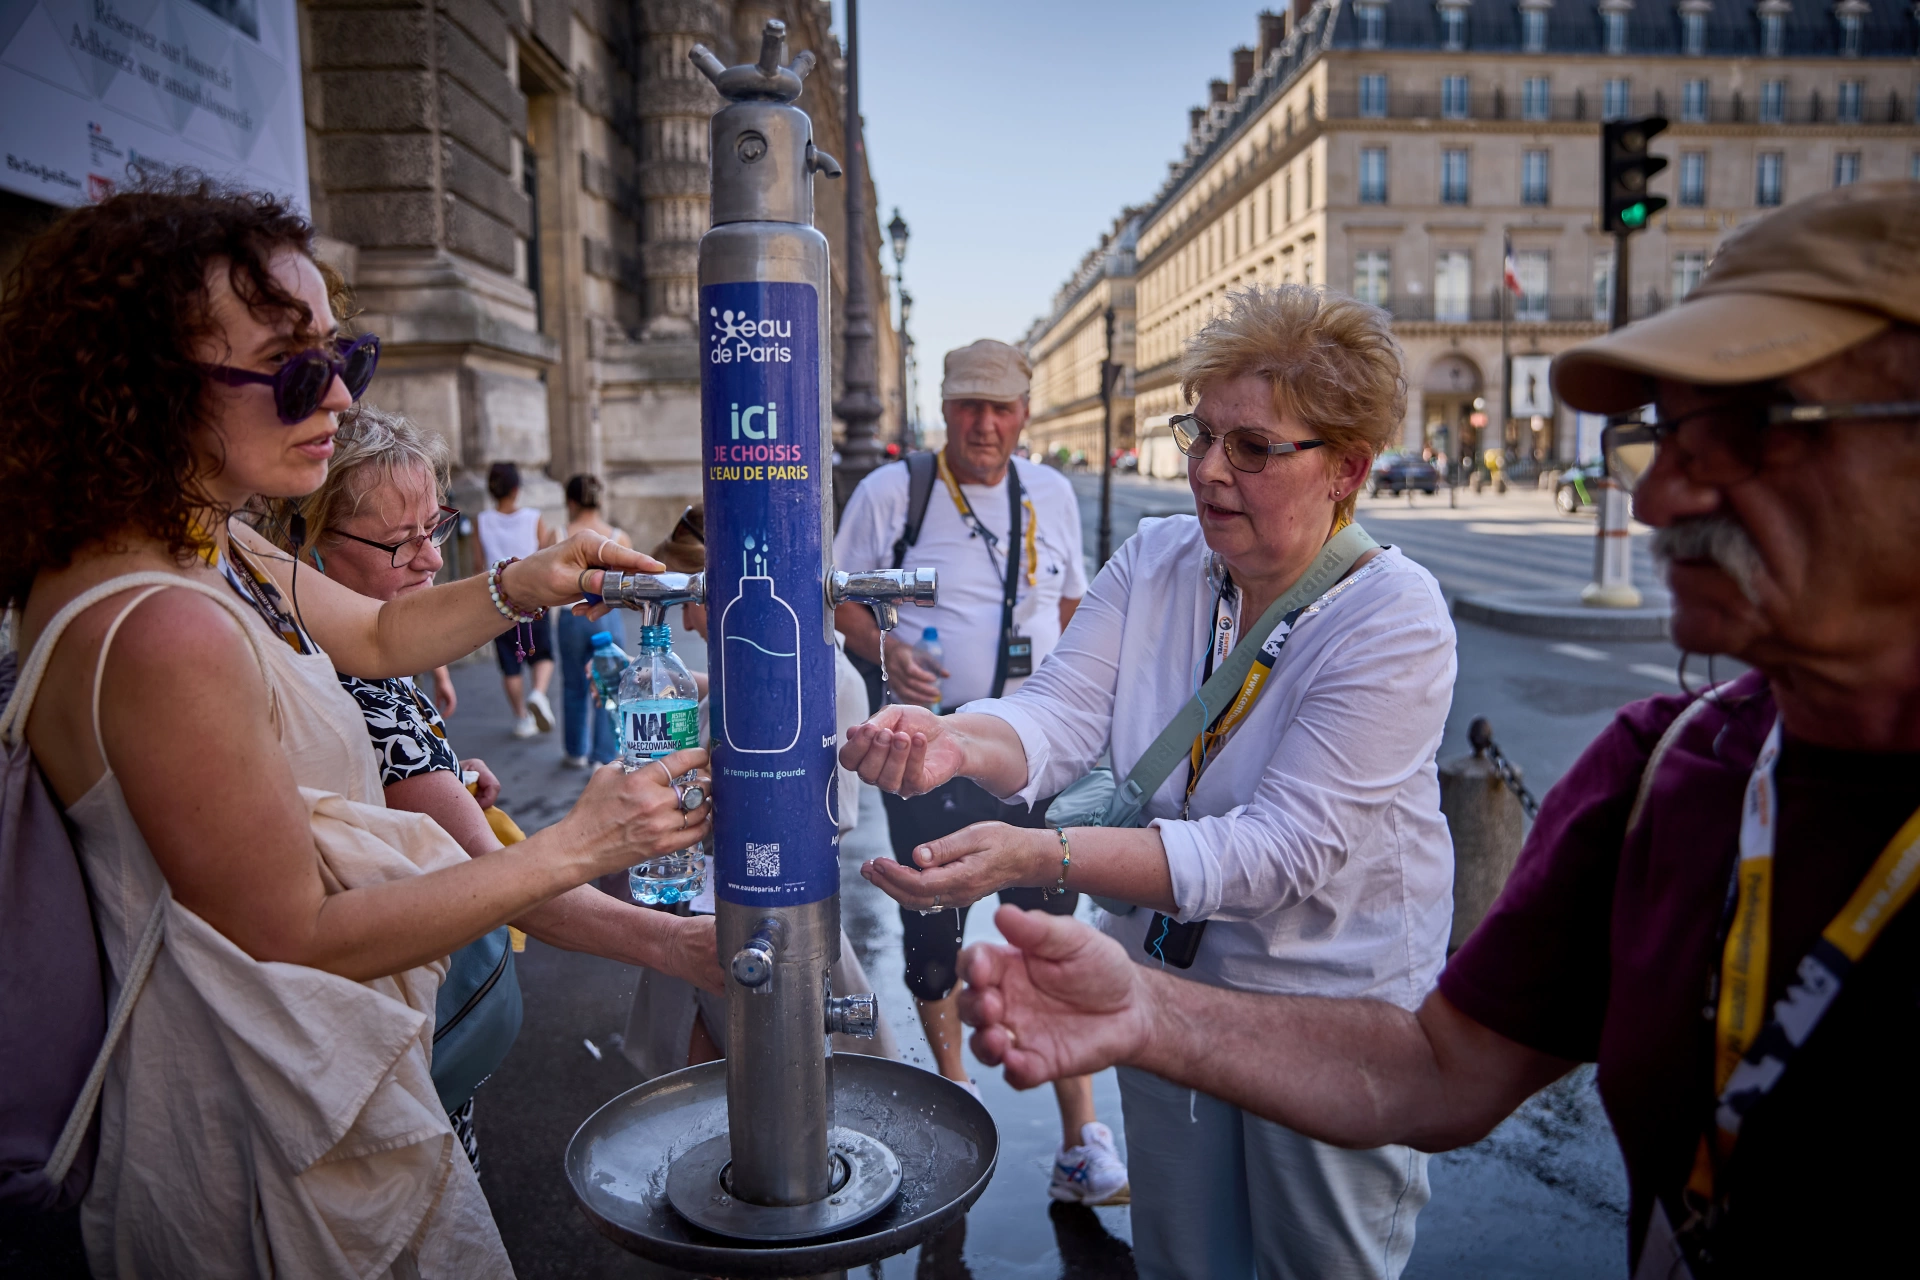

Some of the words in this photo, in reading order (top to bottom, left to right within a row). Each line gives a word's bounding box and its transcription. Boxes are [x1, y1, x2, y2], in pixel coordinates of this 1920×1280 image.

[70, 22, 135, 76] Adhérez
[139, 62, 160, 86] sur
[160, 41, 181, 64] sur
[742, 319, 791, 338] eau
[711, 345, 732, 363] de
[736, 343, 791, 363] Paris
[714, 445, 727, 462] JE
[710, 466, 740, 481] L'EAU
[744, 467, 763, 481] DE
[1217, 632, 1225, 656] TRAVEL
[632, 713, 673, 741] NAŁ
[627, 740, 682, 751] NAŁĘCZOWIANKA
[730, 767, 759, 779] remplis
[761, 770, 774, 778] ma
[776, 767, 806, 780] gourde
[728, 882, 782, 894] www.eaudeparis.fr
